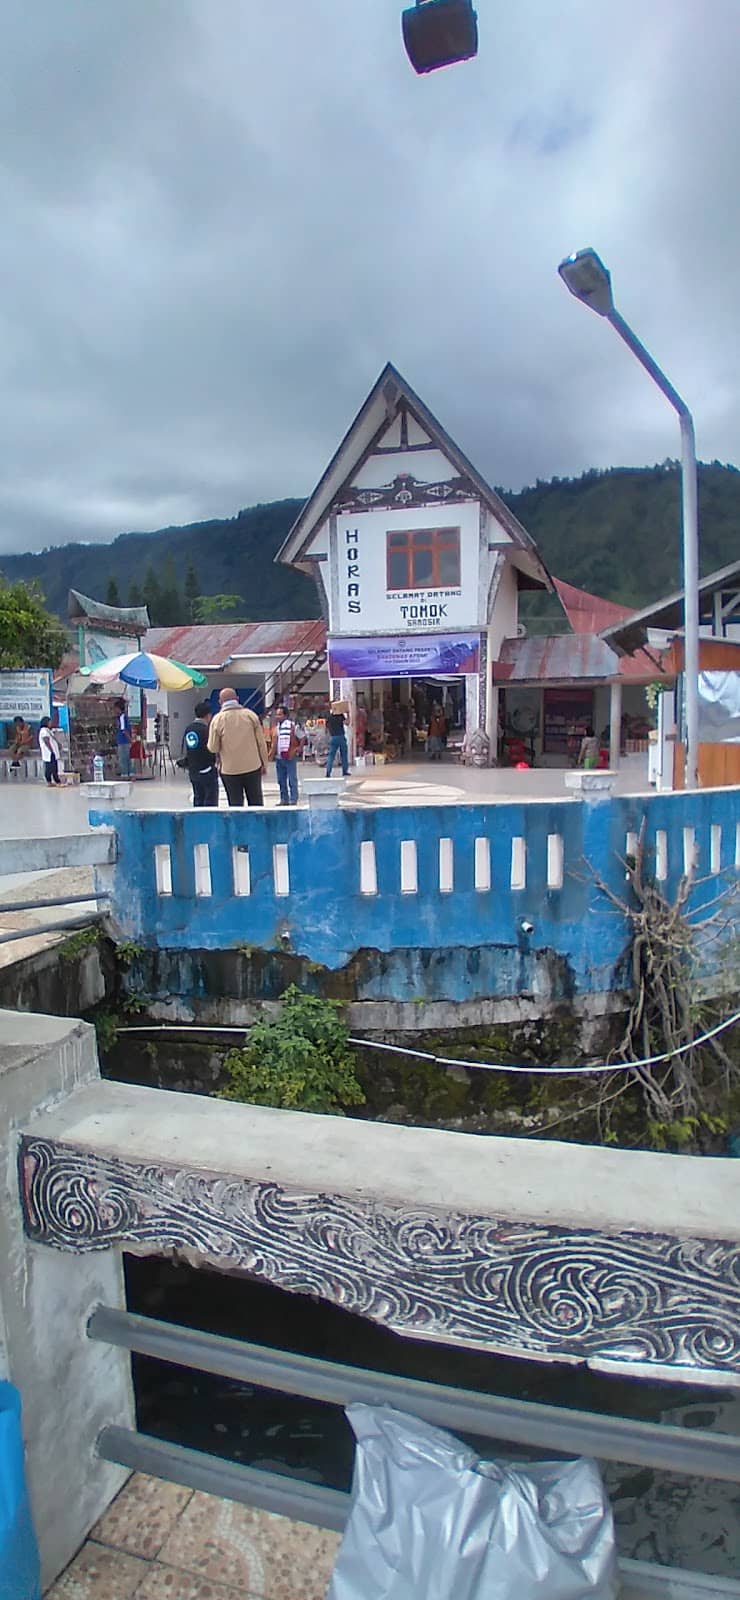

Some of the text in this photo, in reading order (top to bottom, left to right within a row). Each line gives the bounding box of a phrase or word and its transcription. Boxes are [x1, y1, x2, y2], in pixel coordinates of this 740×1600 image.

[346, 529, 361, 614] HORAS
[386, 590, 462, 600] SELAMAT DATANG
[400, 604, 448, 619] TOMOK
[407, 618, 441, 627] SAMOSIR
